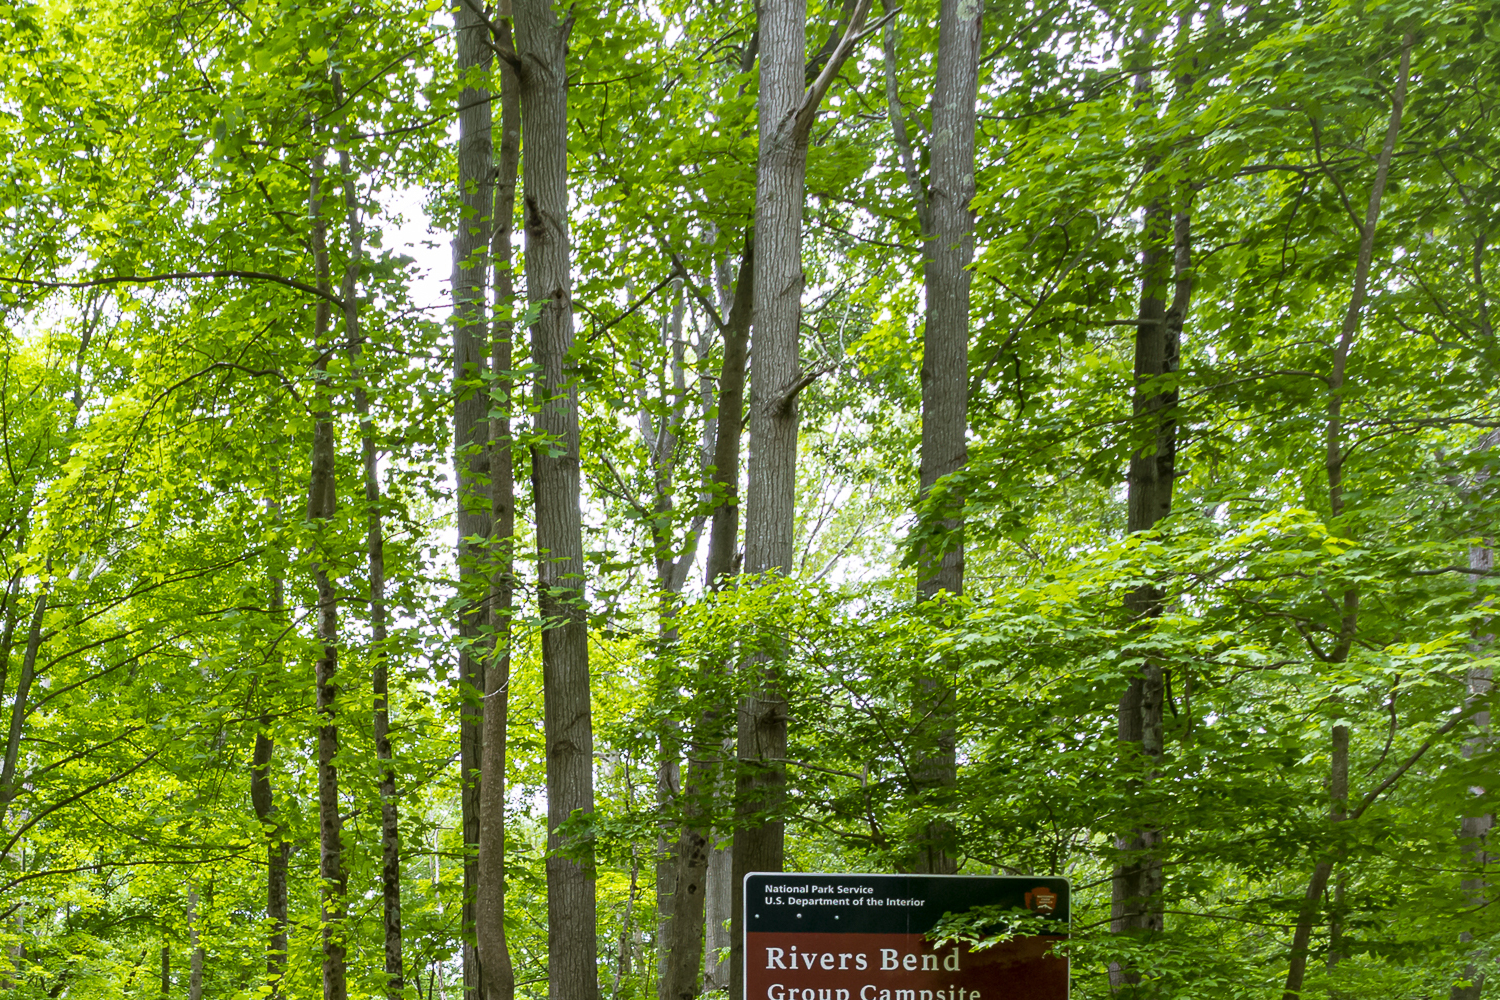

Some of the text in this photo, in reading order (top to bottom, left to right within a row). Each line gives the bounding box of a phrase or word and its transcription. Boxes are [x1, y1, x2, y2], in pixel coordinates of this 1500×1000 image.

[765, 884, 874, 894] National Park Service
[765, 897, 925, 907] U.S. Department of the Interior
[765, 945, 961, 972] Rivers Bend
